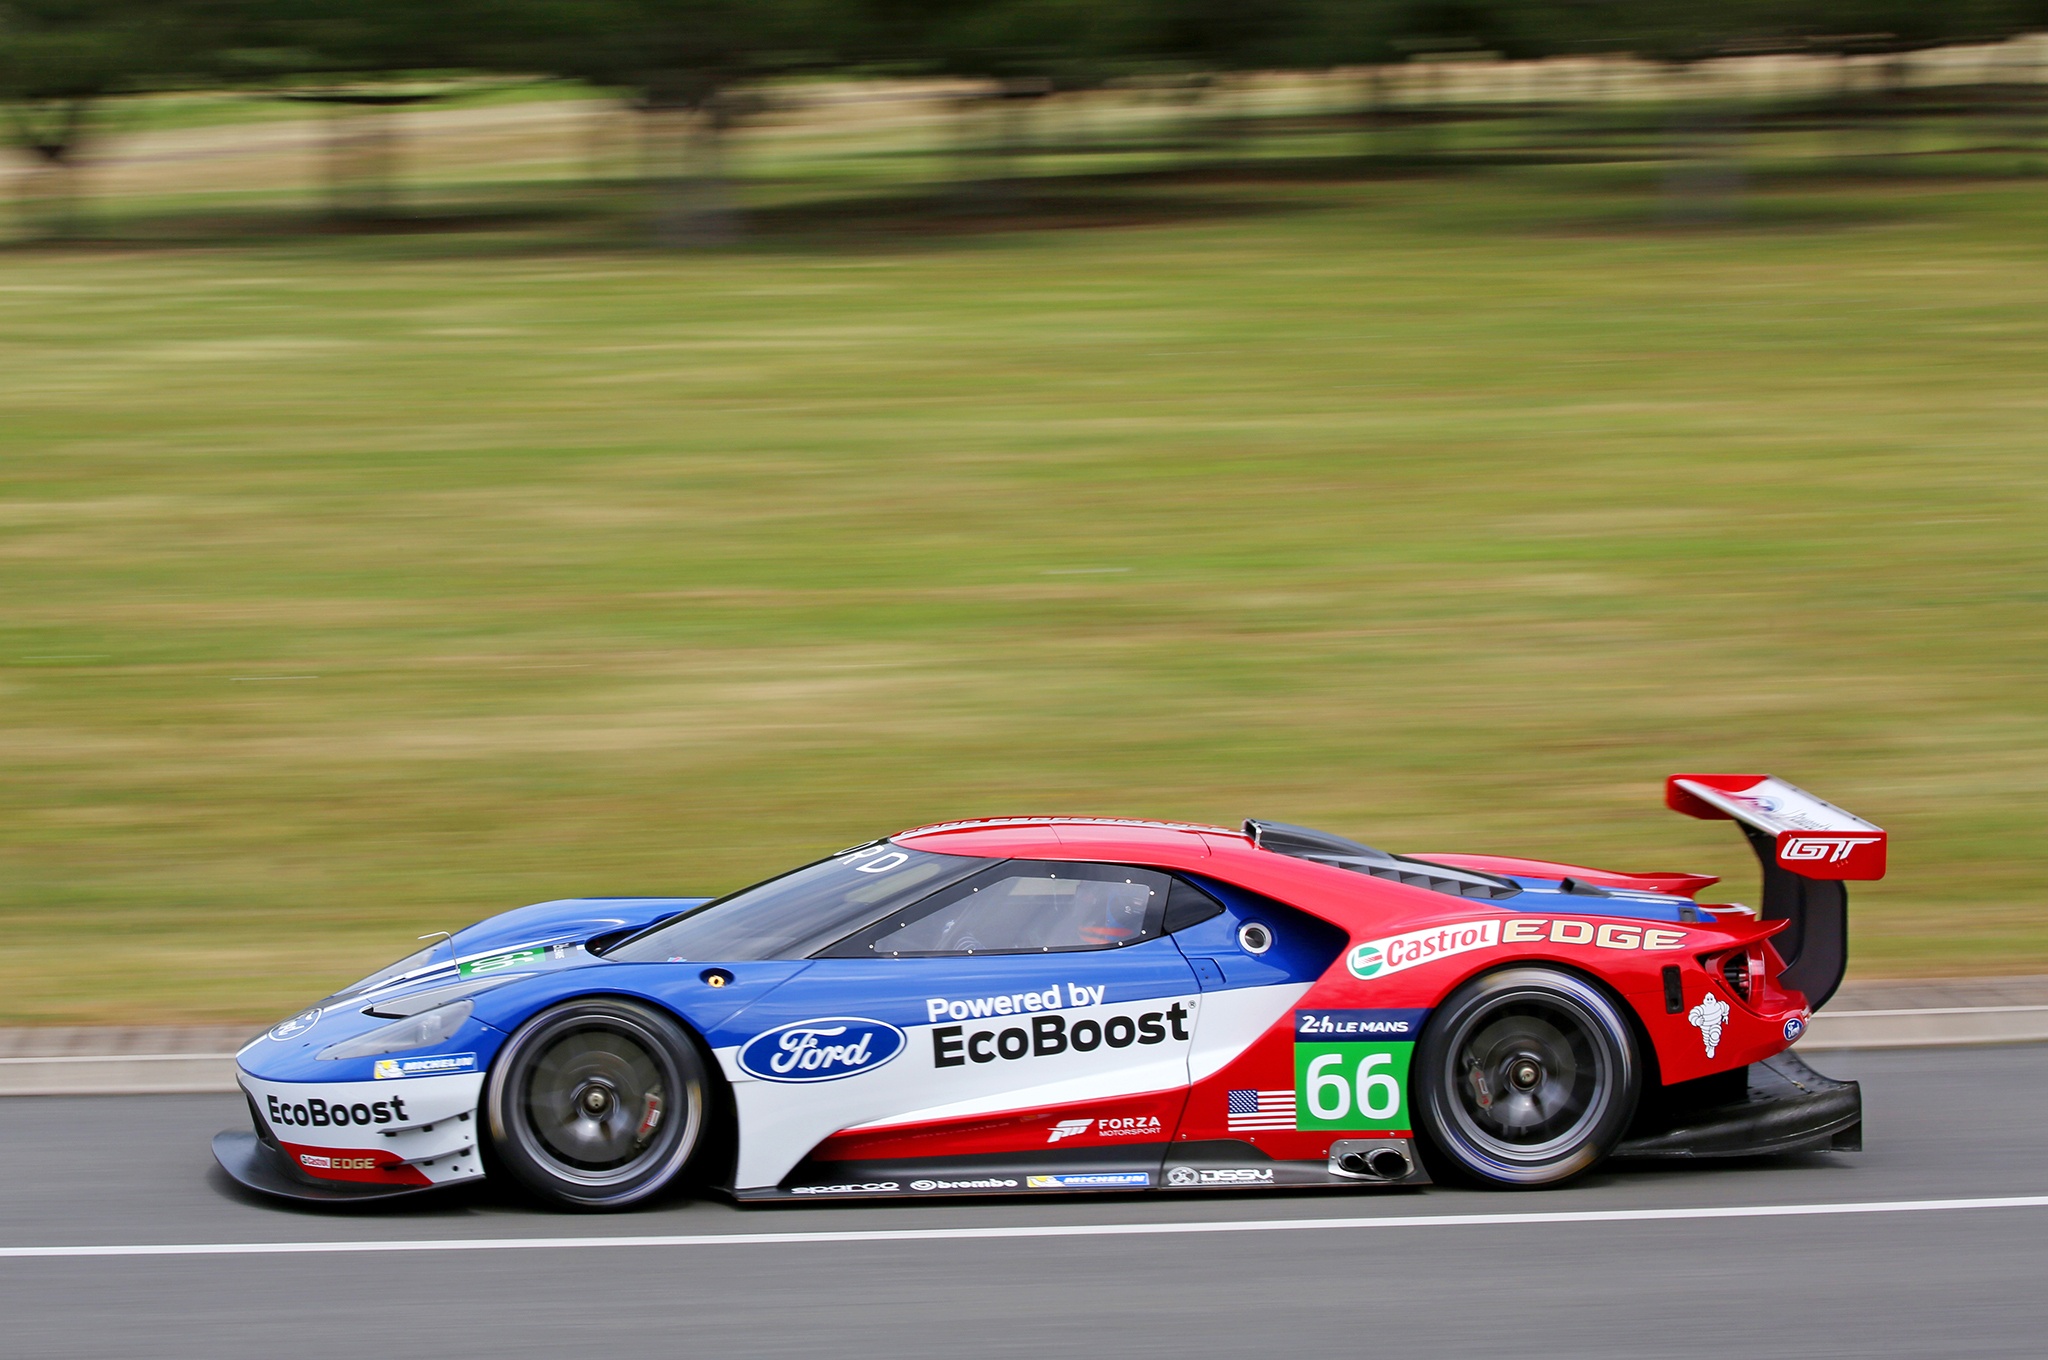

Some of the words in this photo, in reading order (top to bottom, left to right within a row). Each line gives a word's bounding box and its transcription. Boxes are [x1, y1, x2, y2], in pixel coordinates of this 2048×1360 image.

[1781, 838, 1881, 863] GT
[1386, 923, 1490, 968] Castrol
[1502, 919, 1688, 951] EDGE
[926, 984, 1060, 1022] Powered
[1067, 982, 1106, 1007] by
[1336, 1022, 1359, 1033] LE
[1359, 1021, 1409, 1033] MANS
[770, 1026, 873, 1073] Ford
[1306, 1053, 1400, 1120] 66
[267, 1094, 410, 1127] EcoBoost
[1098, 1116, 1161, 1130] FORZA
[1098, 1127, 1161, 1137] MOTORSPORT
[331, 1157, 376, 1169] EDGE
[791, 1181, 900, 1194] sparco
[936, 1178, 1018, 1189] brembo
[1063, 1174, 1146, 1184] MICHELIN
